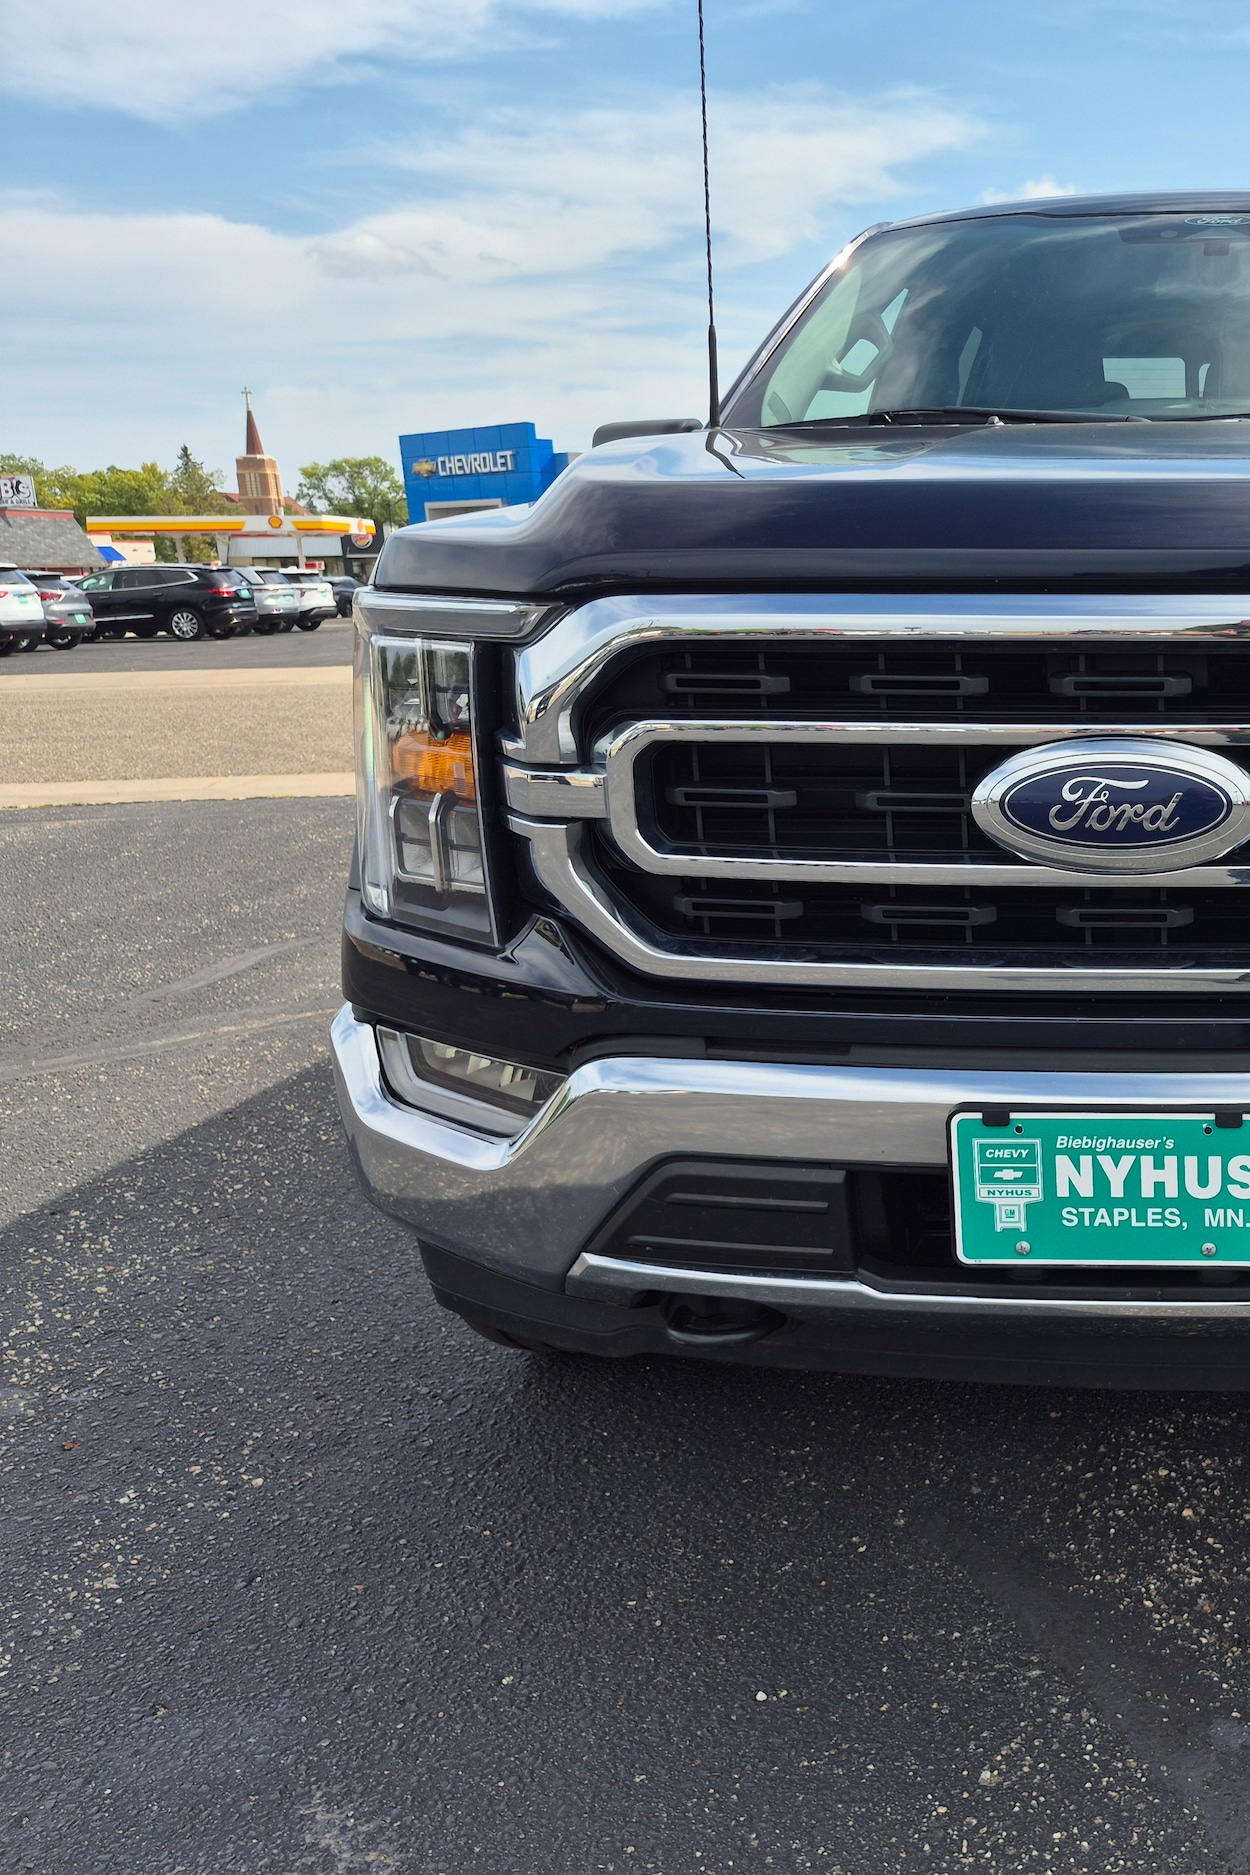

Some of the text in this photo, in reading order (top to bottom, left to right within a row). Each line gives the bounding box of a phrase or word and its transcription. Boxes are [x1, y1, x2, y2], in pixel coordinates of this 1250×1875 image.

[1197, 215, 1243, 225] Ford
[437, 450, 514, 477] CHEVROLET
[1048, 776, 1183, 832] Ford
[1055, 1135, 1175, 1152] Biebighauser's
[985, 1149, 1029, 1158] CHEVY
[1004, 1208, 1016, 1216] GM
[1061, 1207, 1188, 1231] STAPLES,
